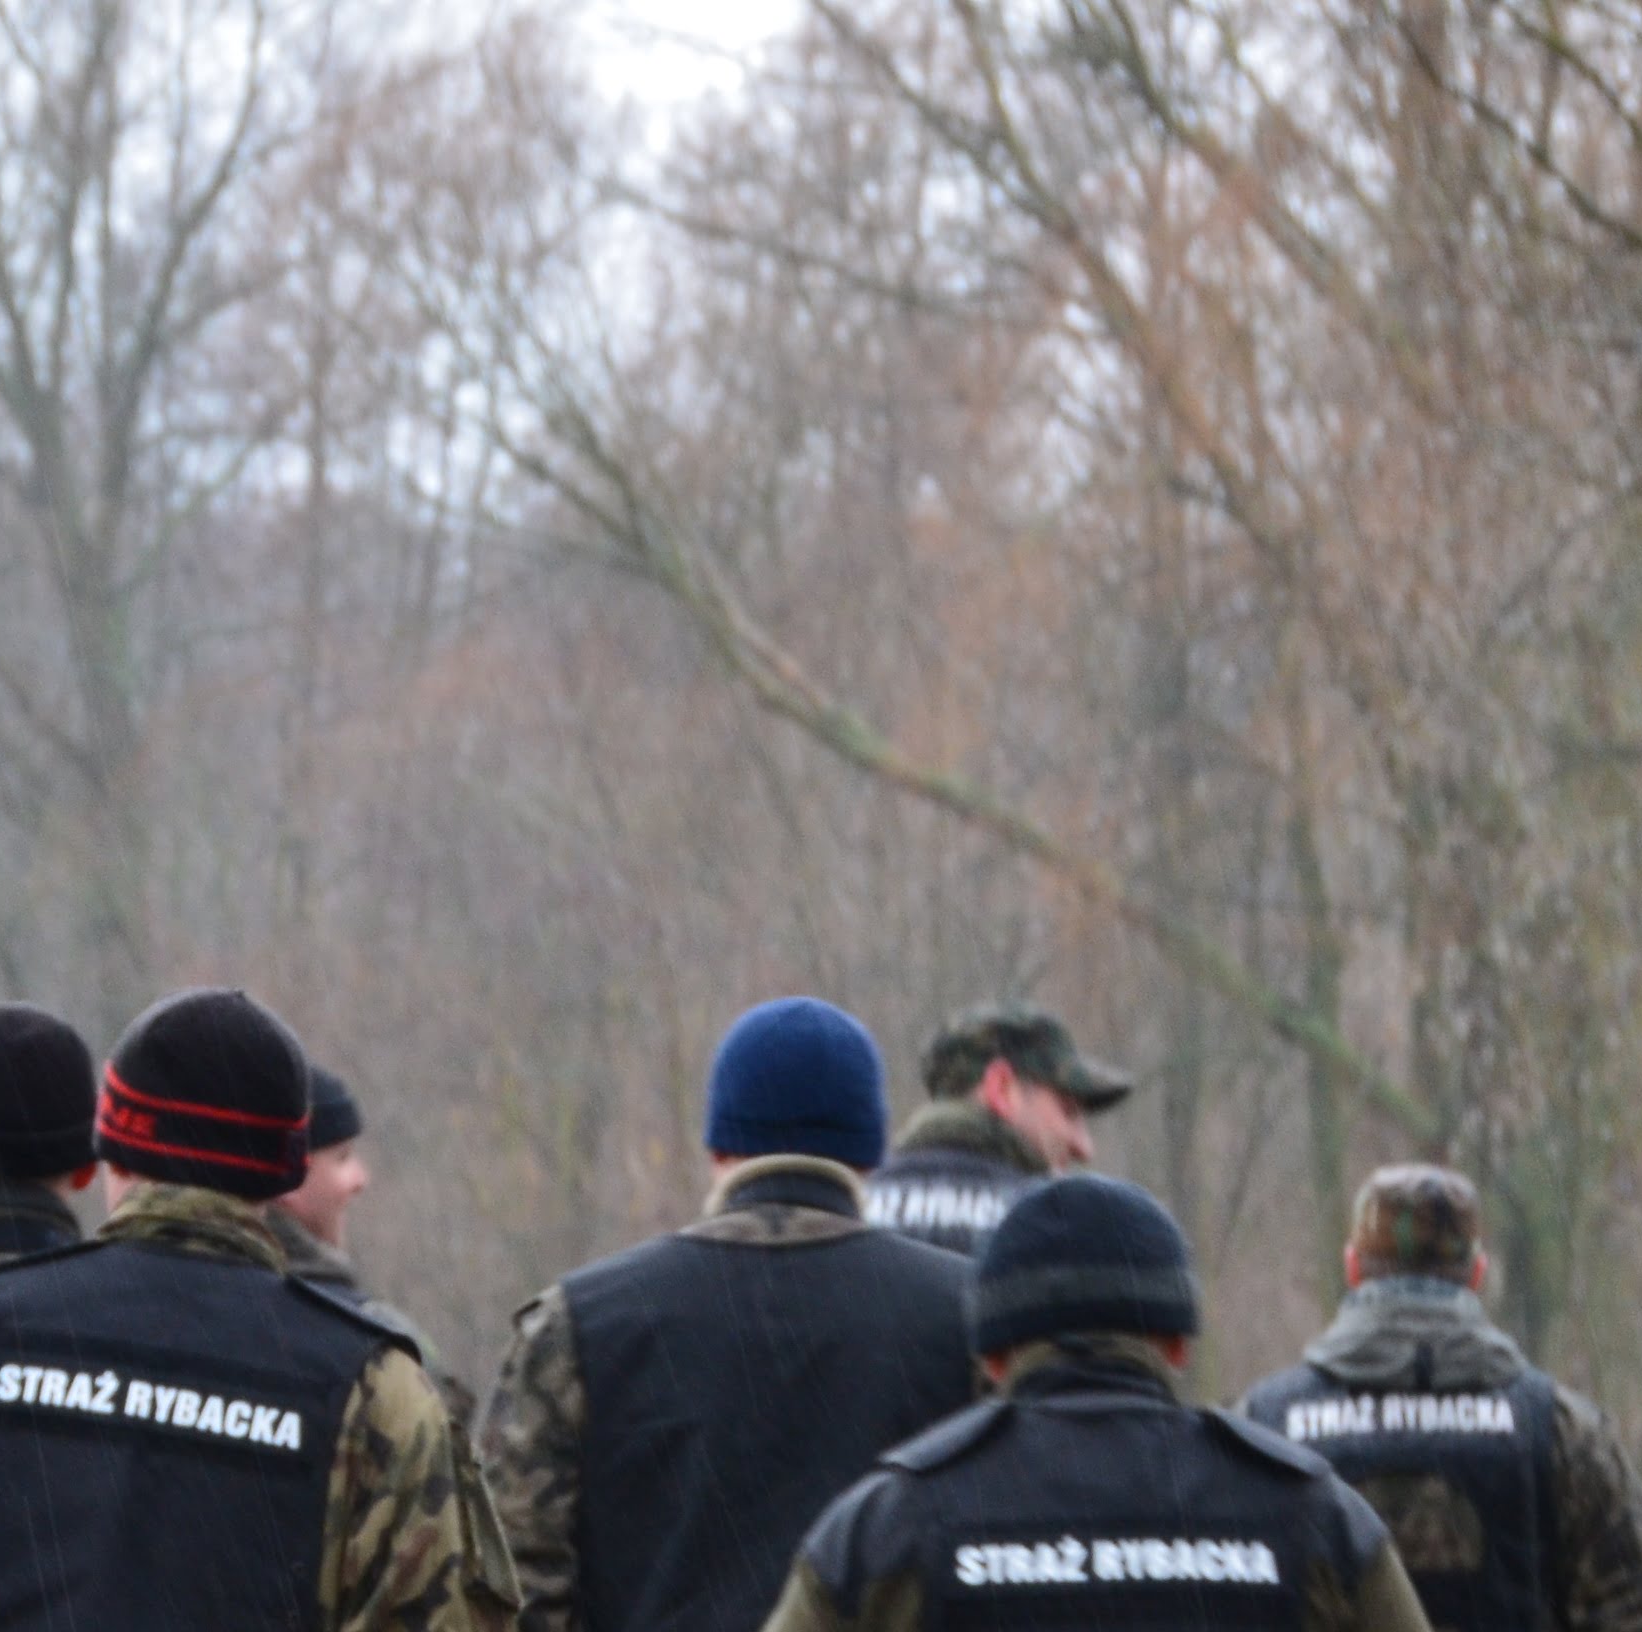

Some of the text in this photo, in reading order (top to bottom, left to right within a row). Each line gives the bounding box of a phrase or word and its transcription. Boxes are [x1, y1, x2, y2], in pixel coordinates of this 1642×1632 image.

[123, 1379, 301, 1450] RYBACKA
[955, 1534, 1279, 1585] STRAŻ RYBACKA
